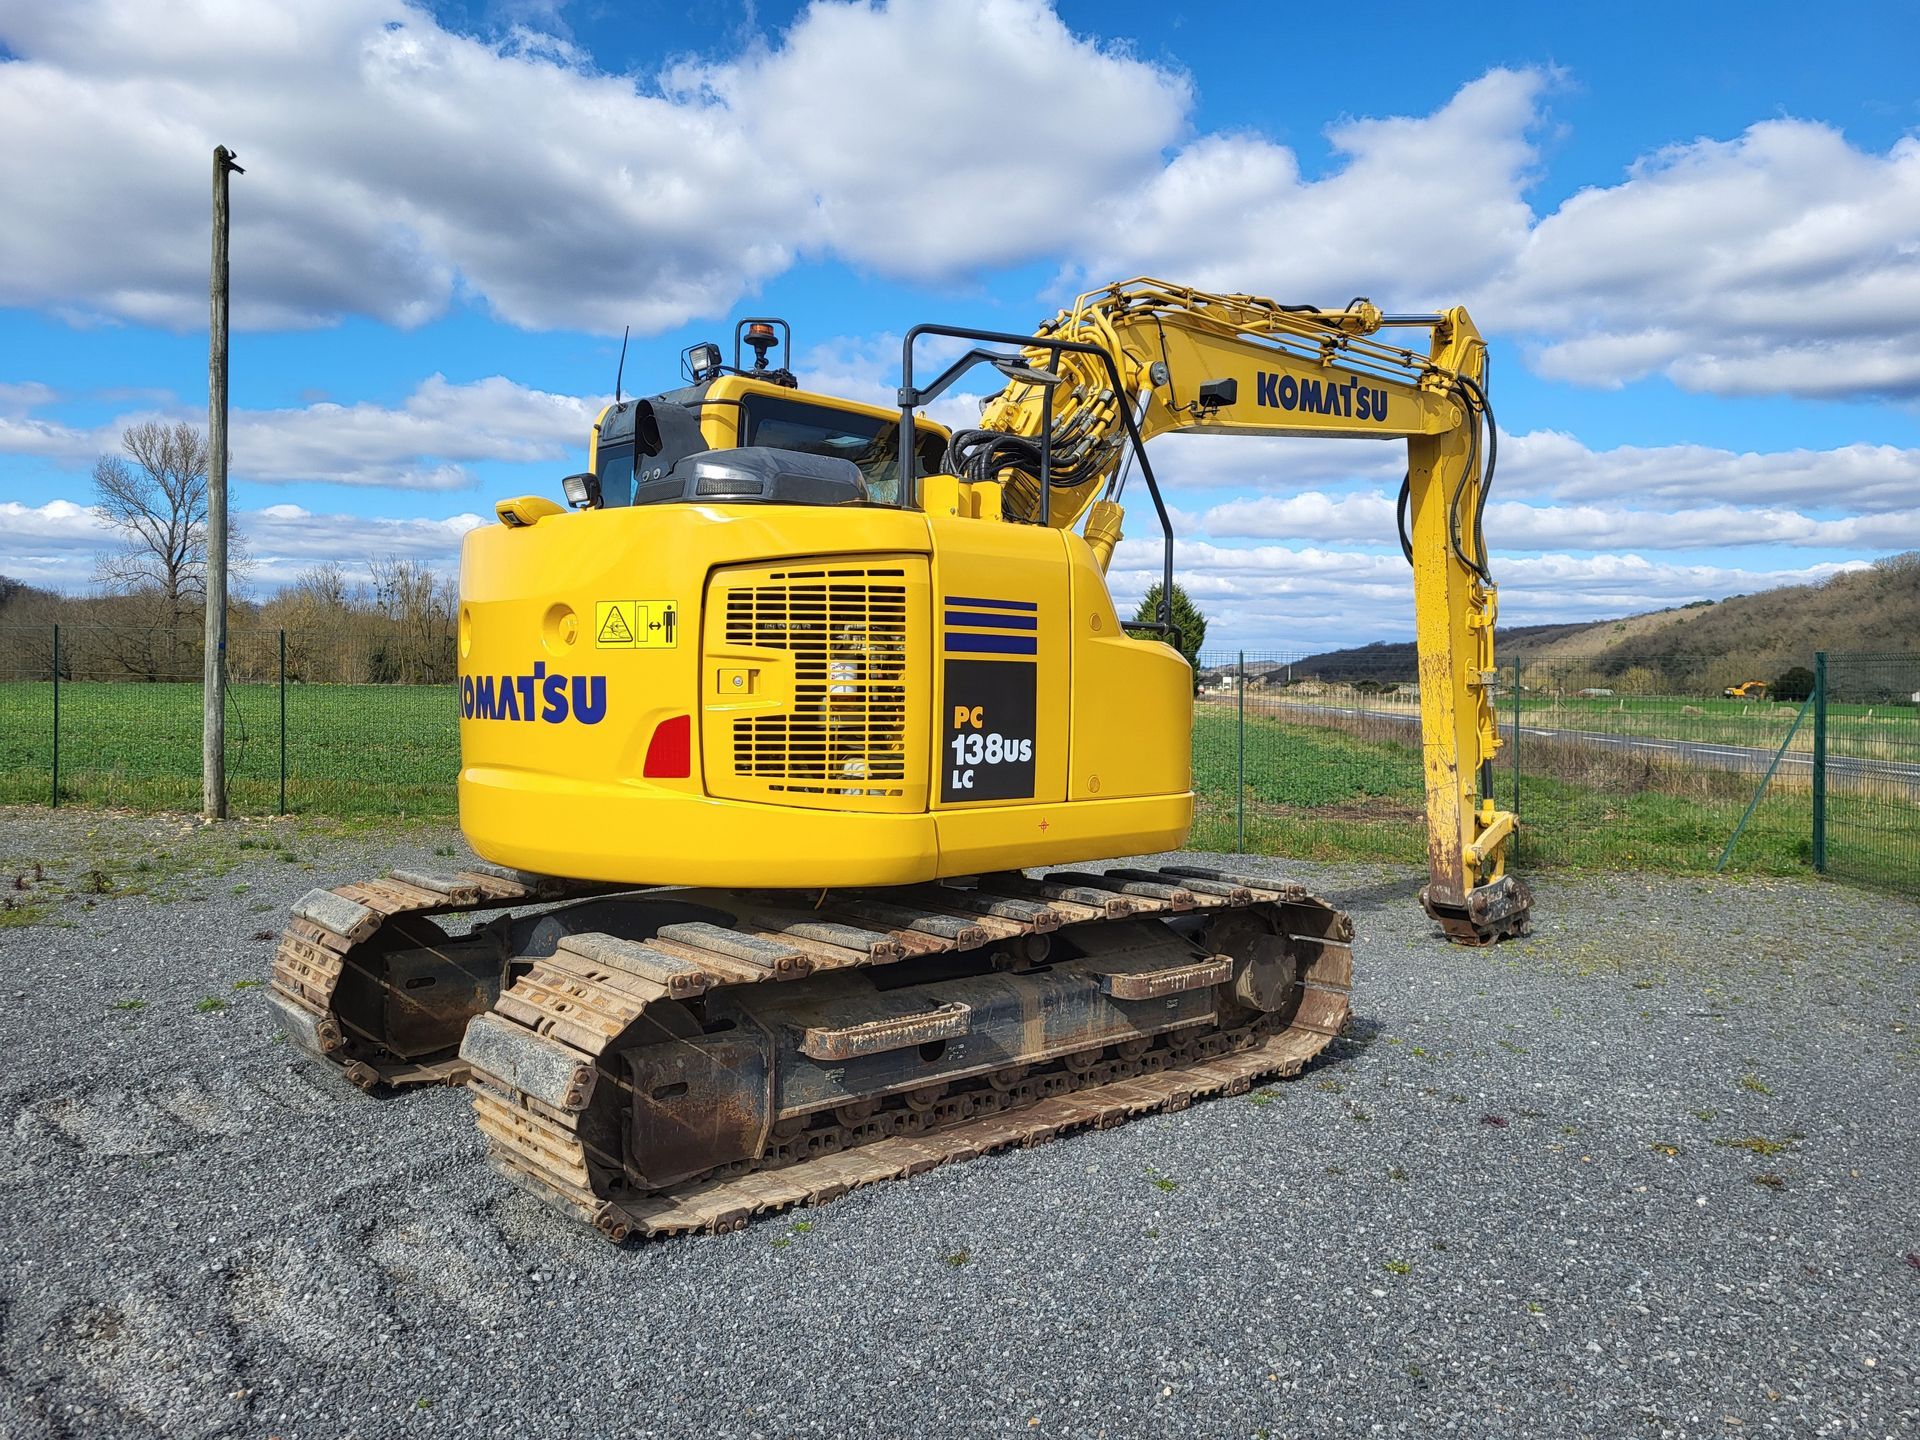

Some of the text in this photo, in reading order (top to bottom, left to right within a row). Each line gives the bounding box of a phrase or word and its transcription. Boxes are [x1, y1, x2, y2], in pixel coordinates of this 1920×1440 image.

[1257, 371, 1388, 422] KOMATSU
[954, 705, 984, 729] PC
[952, 769, 974, 789] LC
